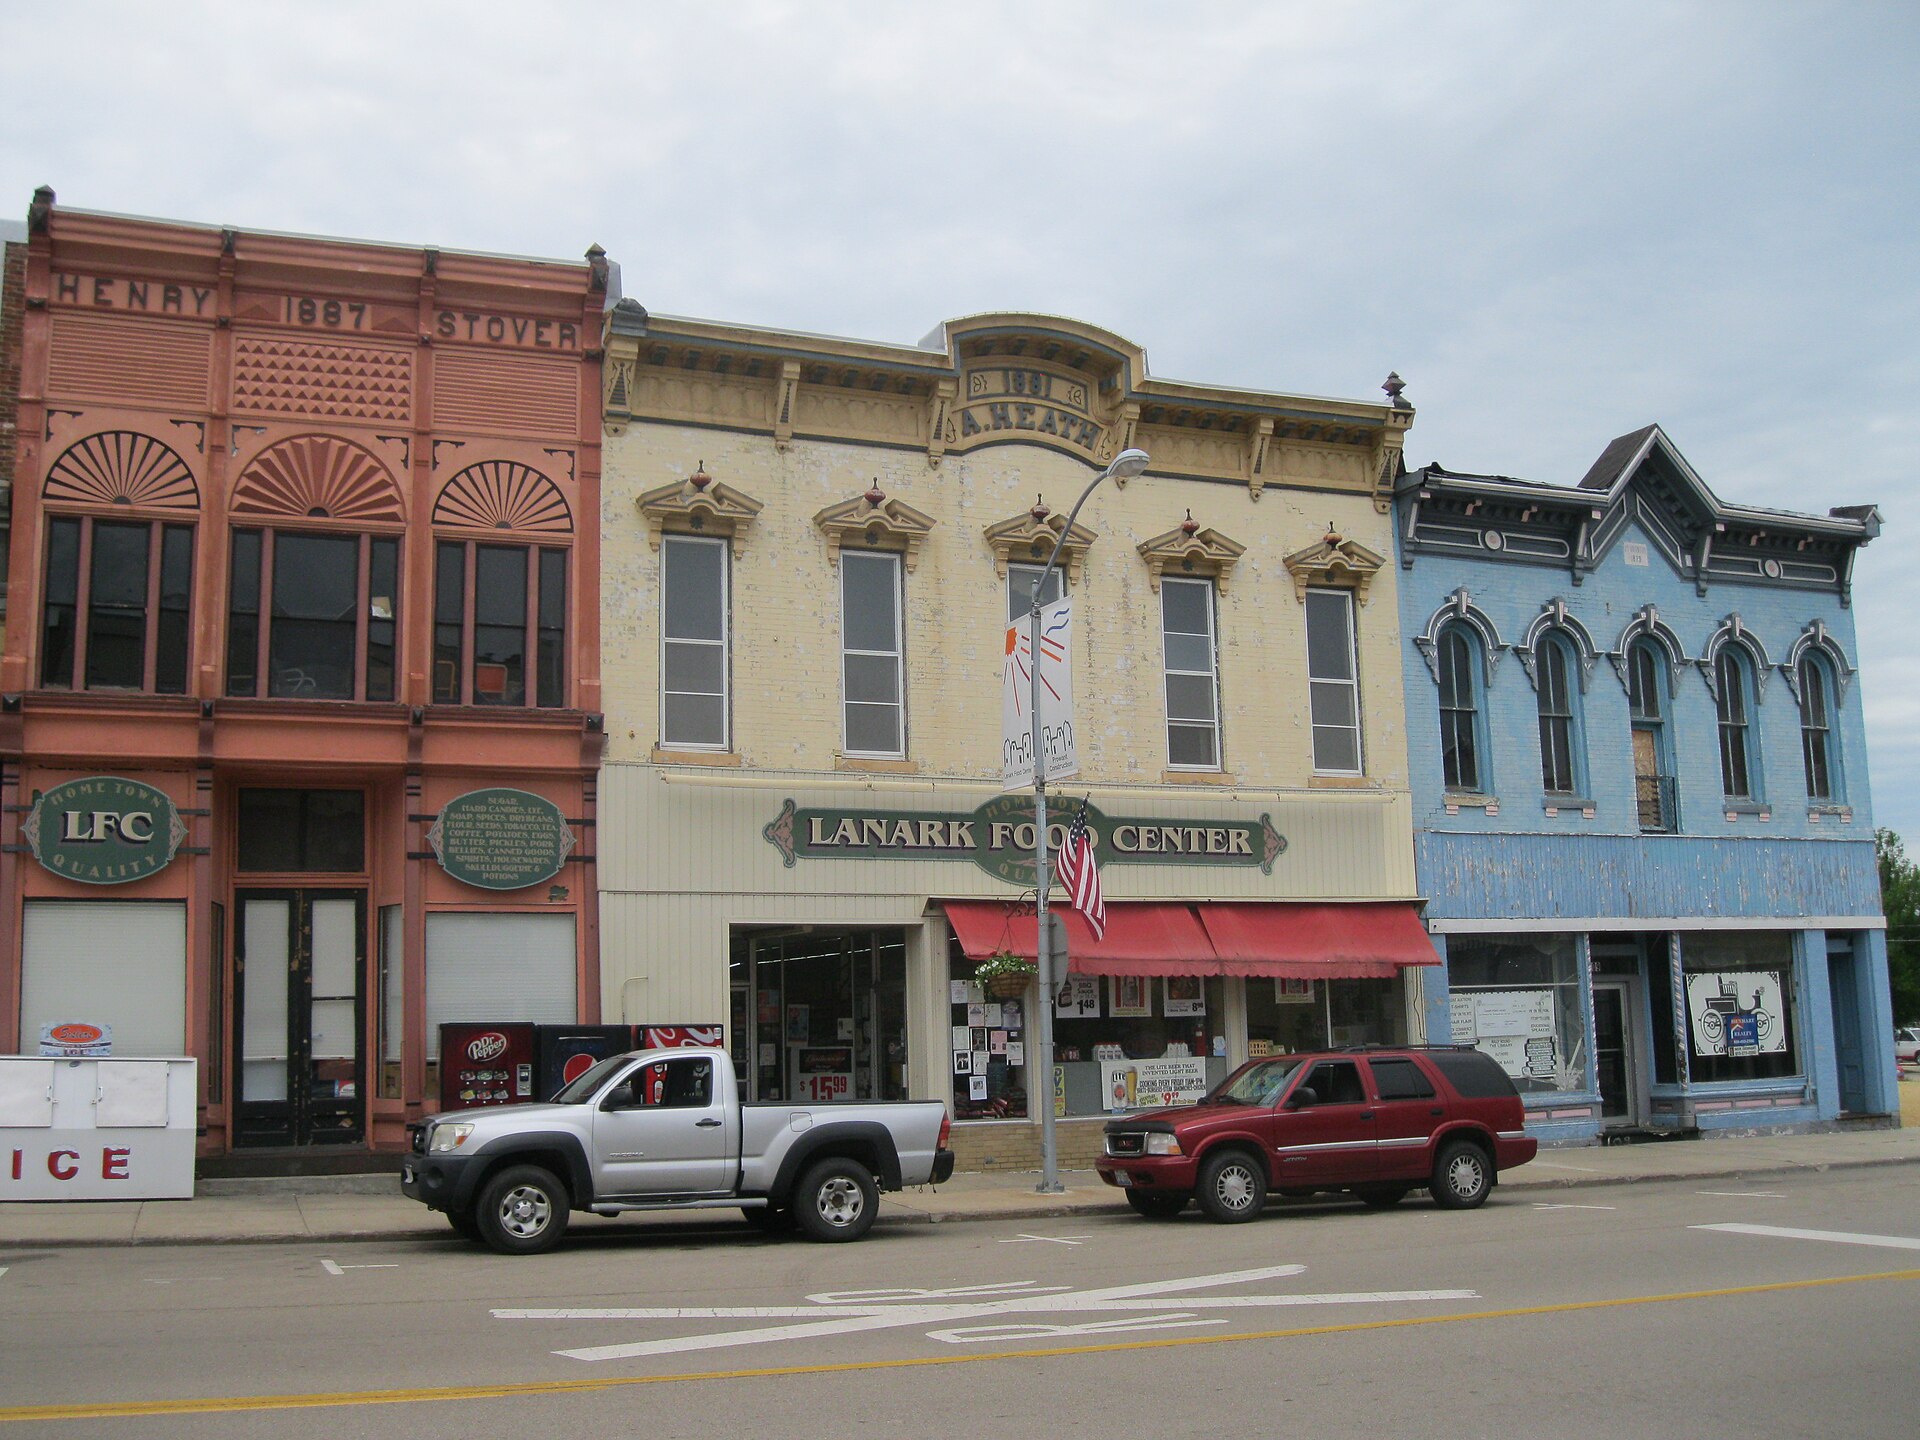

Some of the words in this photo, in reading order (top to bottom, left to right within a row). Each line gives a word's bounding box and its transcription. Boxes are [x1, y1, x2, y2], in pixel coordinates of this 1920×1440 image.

[58, 273, 210, 315] HENRY
[286, 296, 366, 329] 1887
[436, 311, 577, 348] STOVER
[50, 782, 105, 806] HOME
[115, 783, 162, 808] TOWN
[63, 811, 154, 843] LFC
[809, 817, 977, 849] LANARK
[1112, 825, 1253, 855] CENTER
[53, 853, 157, 878] QUALITY
[467, 1038, 505, 1060] Pepper
[481, 1036, 495, 1048] Dr
[12, 1145, 131, 1180] ICE
